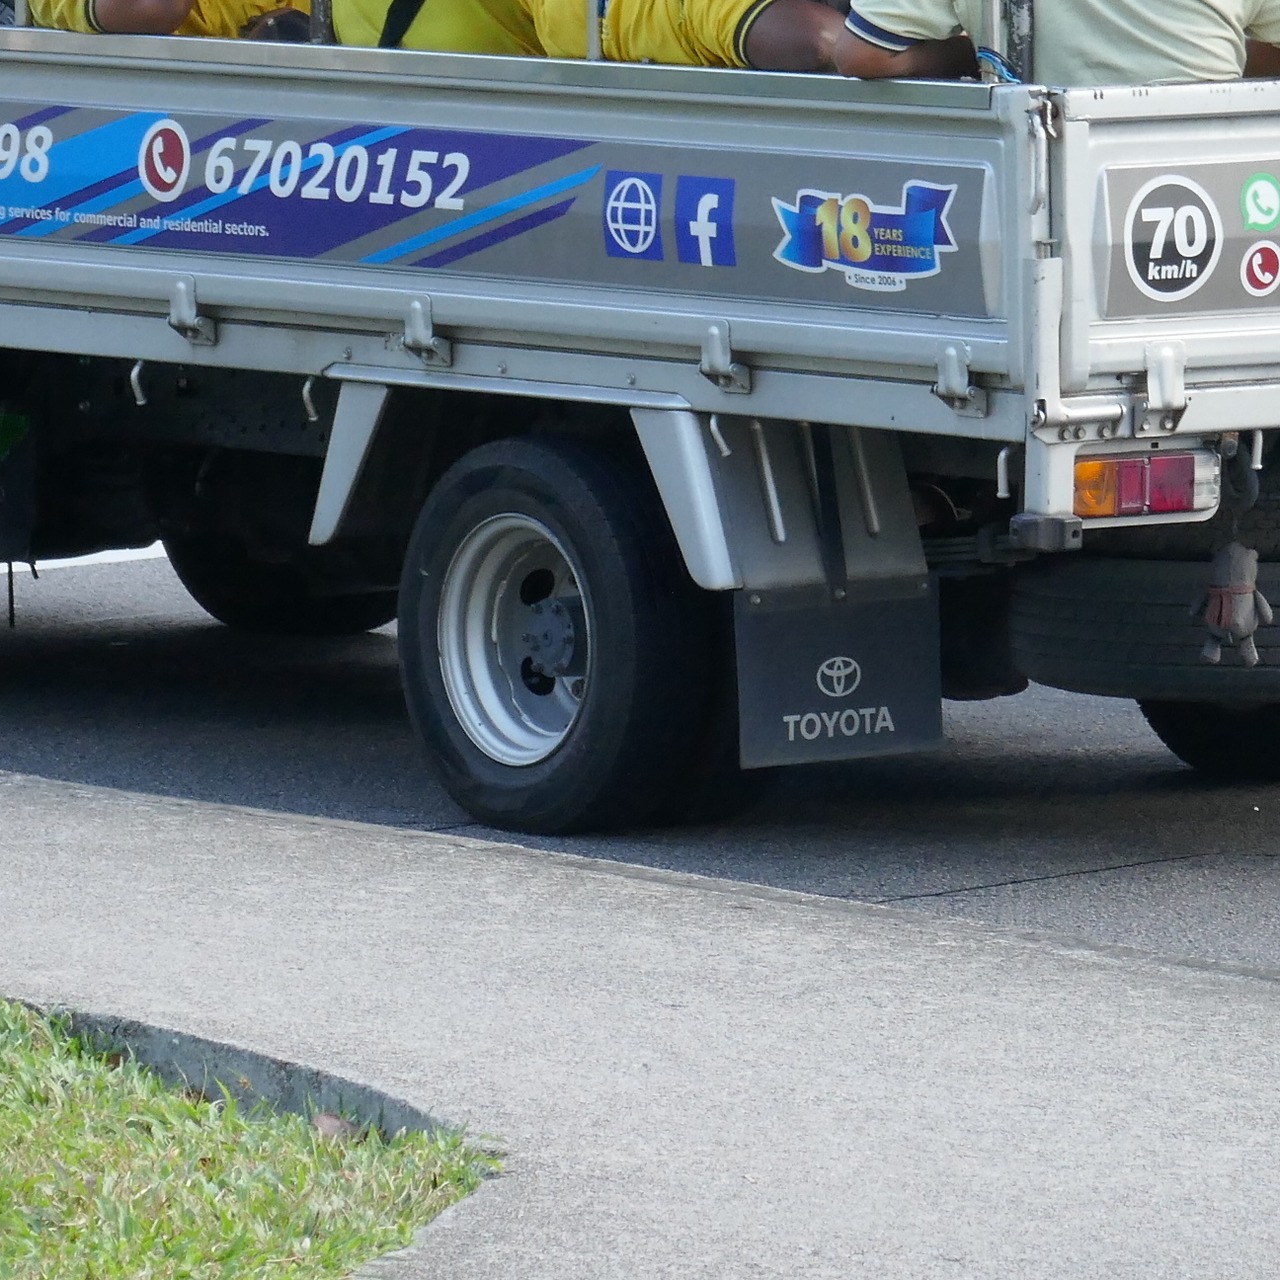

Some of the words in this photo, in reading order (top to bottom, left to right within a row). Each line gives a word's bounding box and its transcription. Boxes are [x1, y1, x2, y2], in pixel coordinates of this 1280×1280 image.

[205, 136, 470, 211] 67020152
[8, 206, 53, 221] services
[55, 207, 71, 222] for
[73, 211, 137, 228] commercial
[140, 215, 160, 229] and
[162, 217, 222, 234] residential
[225, 222, 270, 237] sectors.
[815, 198, 872, 263] 18
[873, 227, 903, 242] YEARS
[1141, 205, 1208, 260] 70
[874, 243, 933, 260] EXPERIENCE
[854, 273, 876, 285] Since
[878, 275, 897, 287] 2006
[1147, 259, 1198, 281] km/h
[782, 706, 895, 741] TOYOTA
